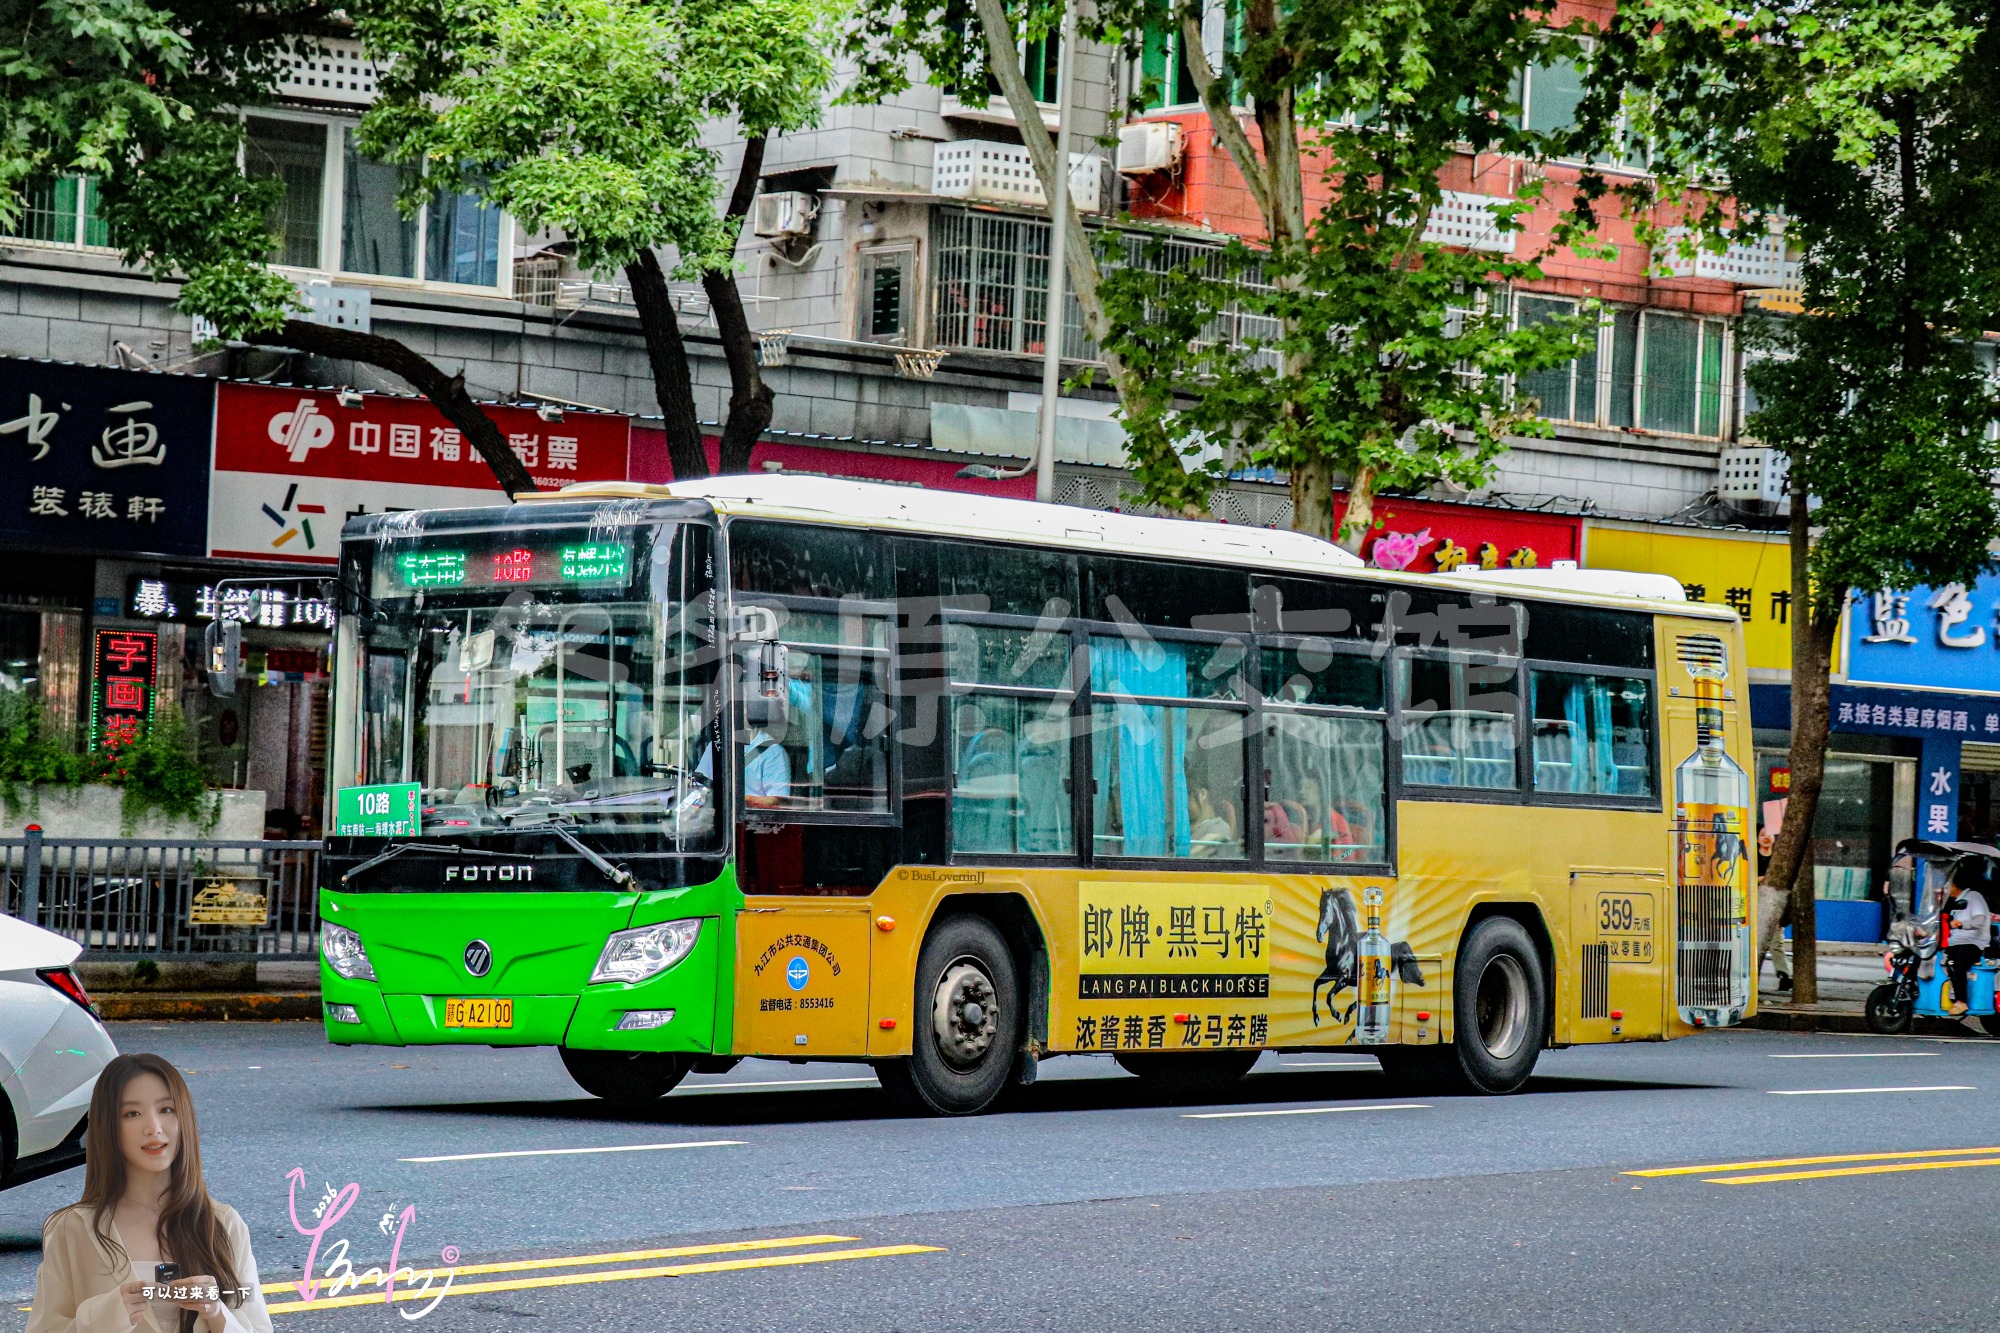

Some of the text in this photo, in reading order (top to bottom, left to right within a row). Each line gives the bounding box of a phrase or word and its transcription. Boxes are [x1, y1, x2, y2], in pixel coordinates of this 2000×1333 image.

[350, 421, 578, 471] 中国福彩票
[357, 792, 390, 815] 10路
[1927, 766, 1952, 834] 水果
[446, 865, 533, 882] FOTON
[754, 934, 841, 977] 九江市公共交通集团公司
[1082, 979, 1266, 994] LANG PAI BLACK HORSE
[1076, 1013, 1268, 1049] 浓酱兼香 龙马奔腾
